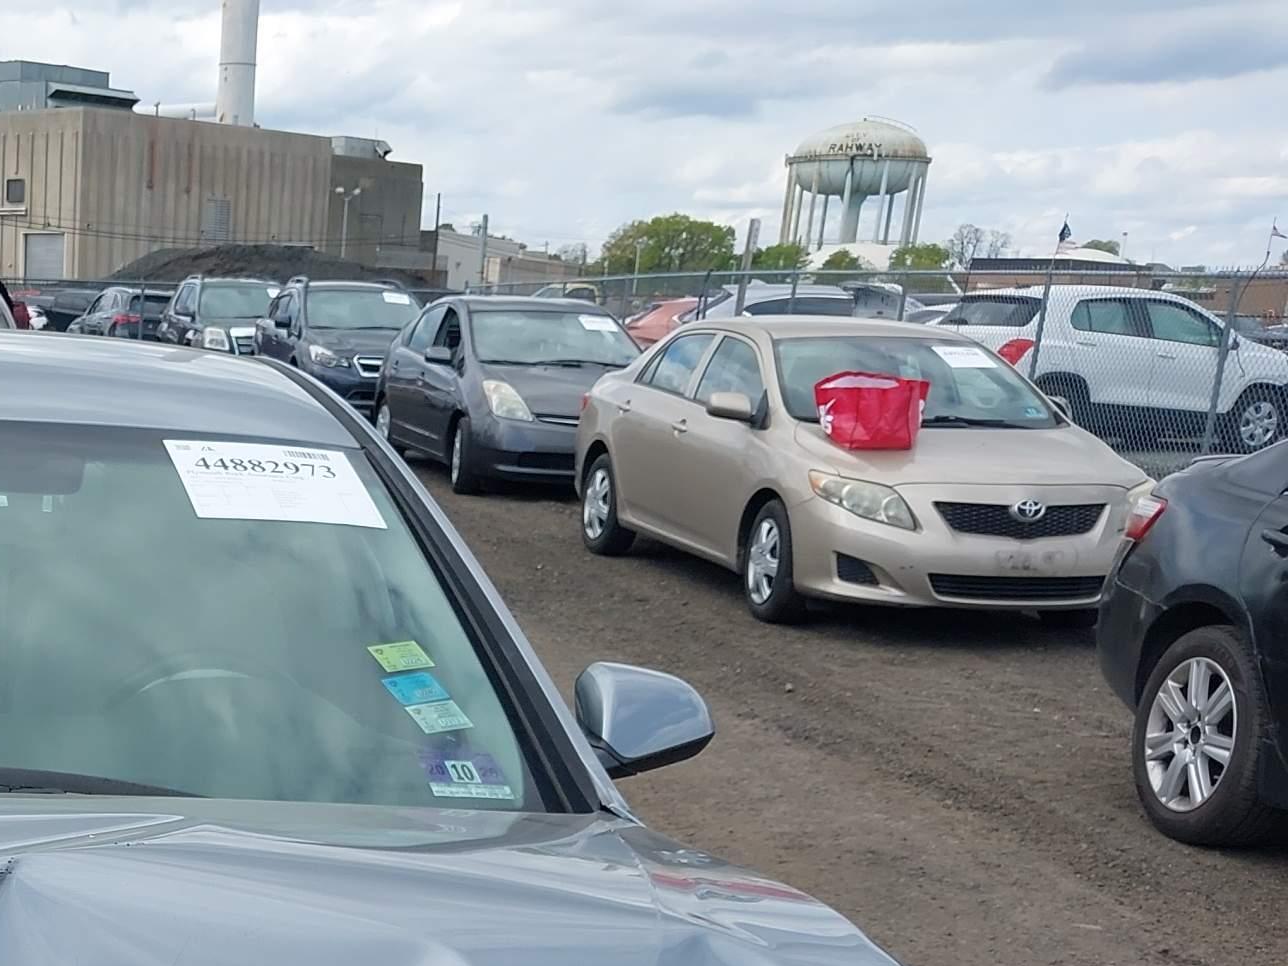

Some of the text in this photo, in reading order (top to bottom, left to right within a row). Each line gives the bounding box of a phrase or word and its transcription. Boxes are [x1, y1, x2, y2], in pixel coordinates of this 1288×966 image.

[828, 142, 883, 153] RAHWAY
[195, 457, 336, 479] 44882973
[450, 763, 475, 781] 10
